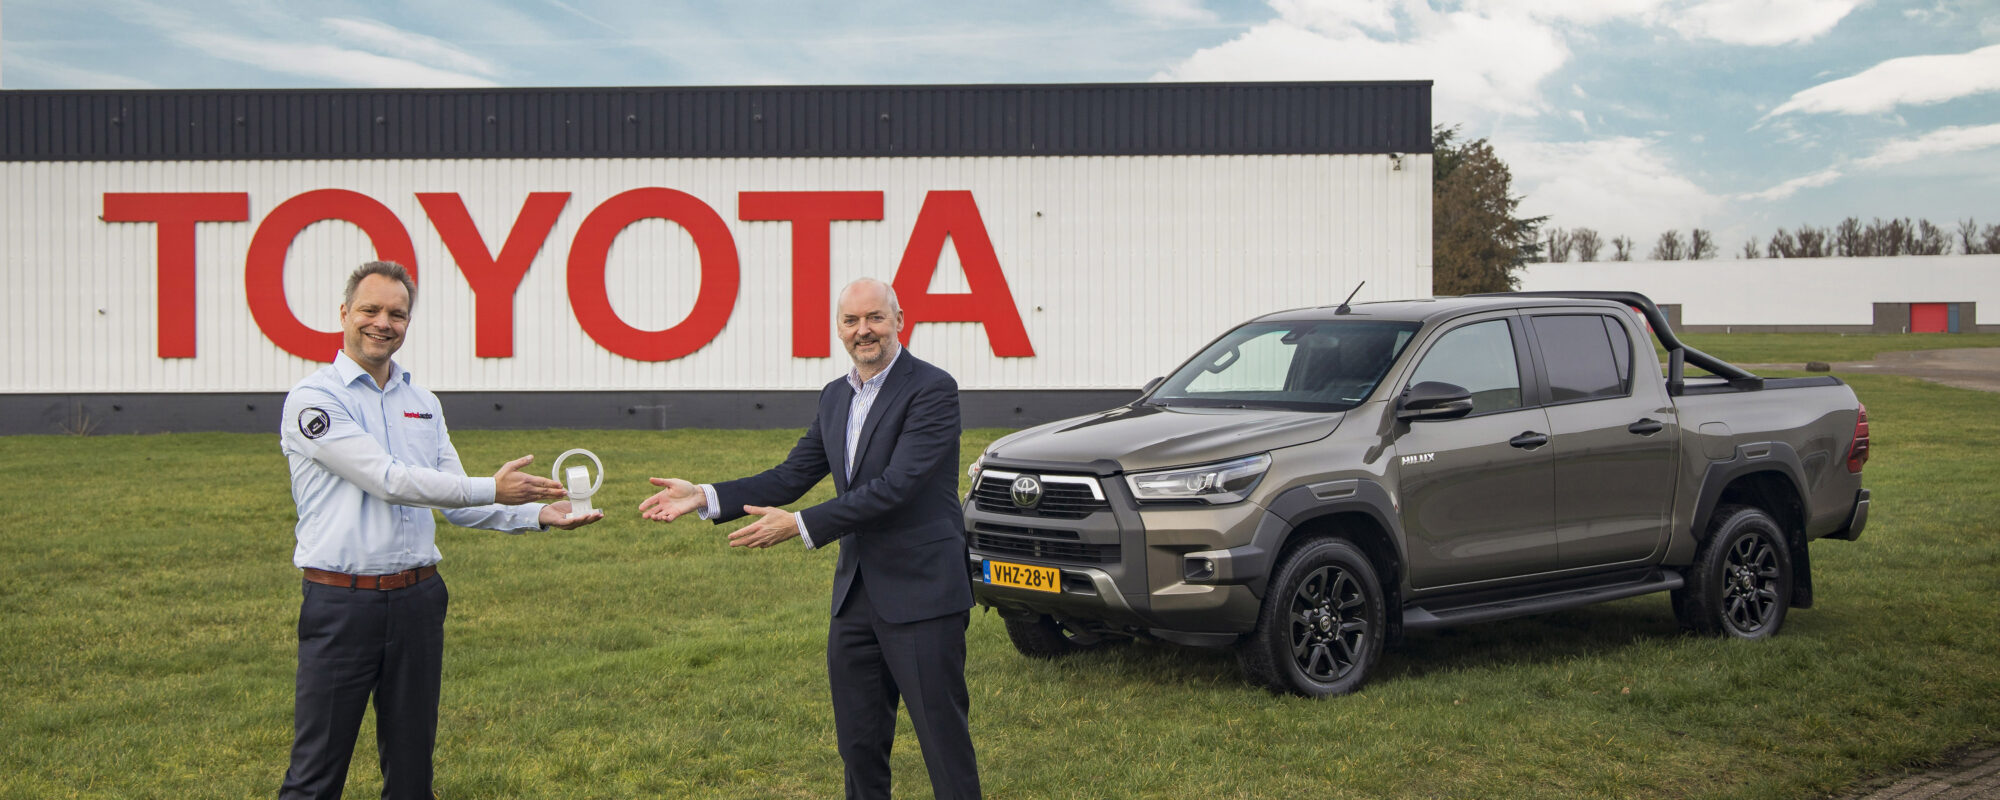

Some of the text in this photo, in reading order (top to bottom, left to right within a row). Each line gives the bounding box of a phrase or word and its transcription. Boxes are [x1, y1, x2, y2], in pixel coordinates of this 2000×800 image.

[103, 187, 1036, 362] TOYOTA
[1401, 452, 1435, 466] HILUX
[993, 564, 1055, 589] VHZ-28-V
